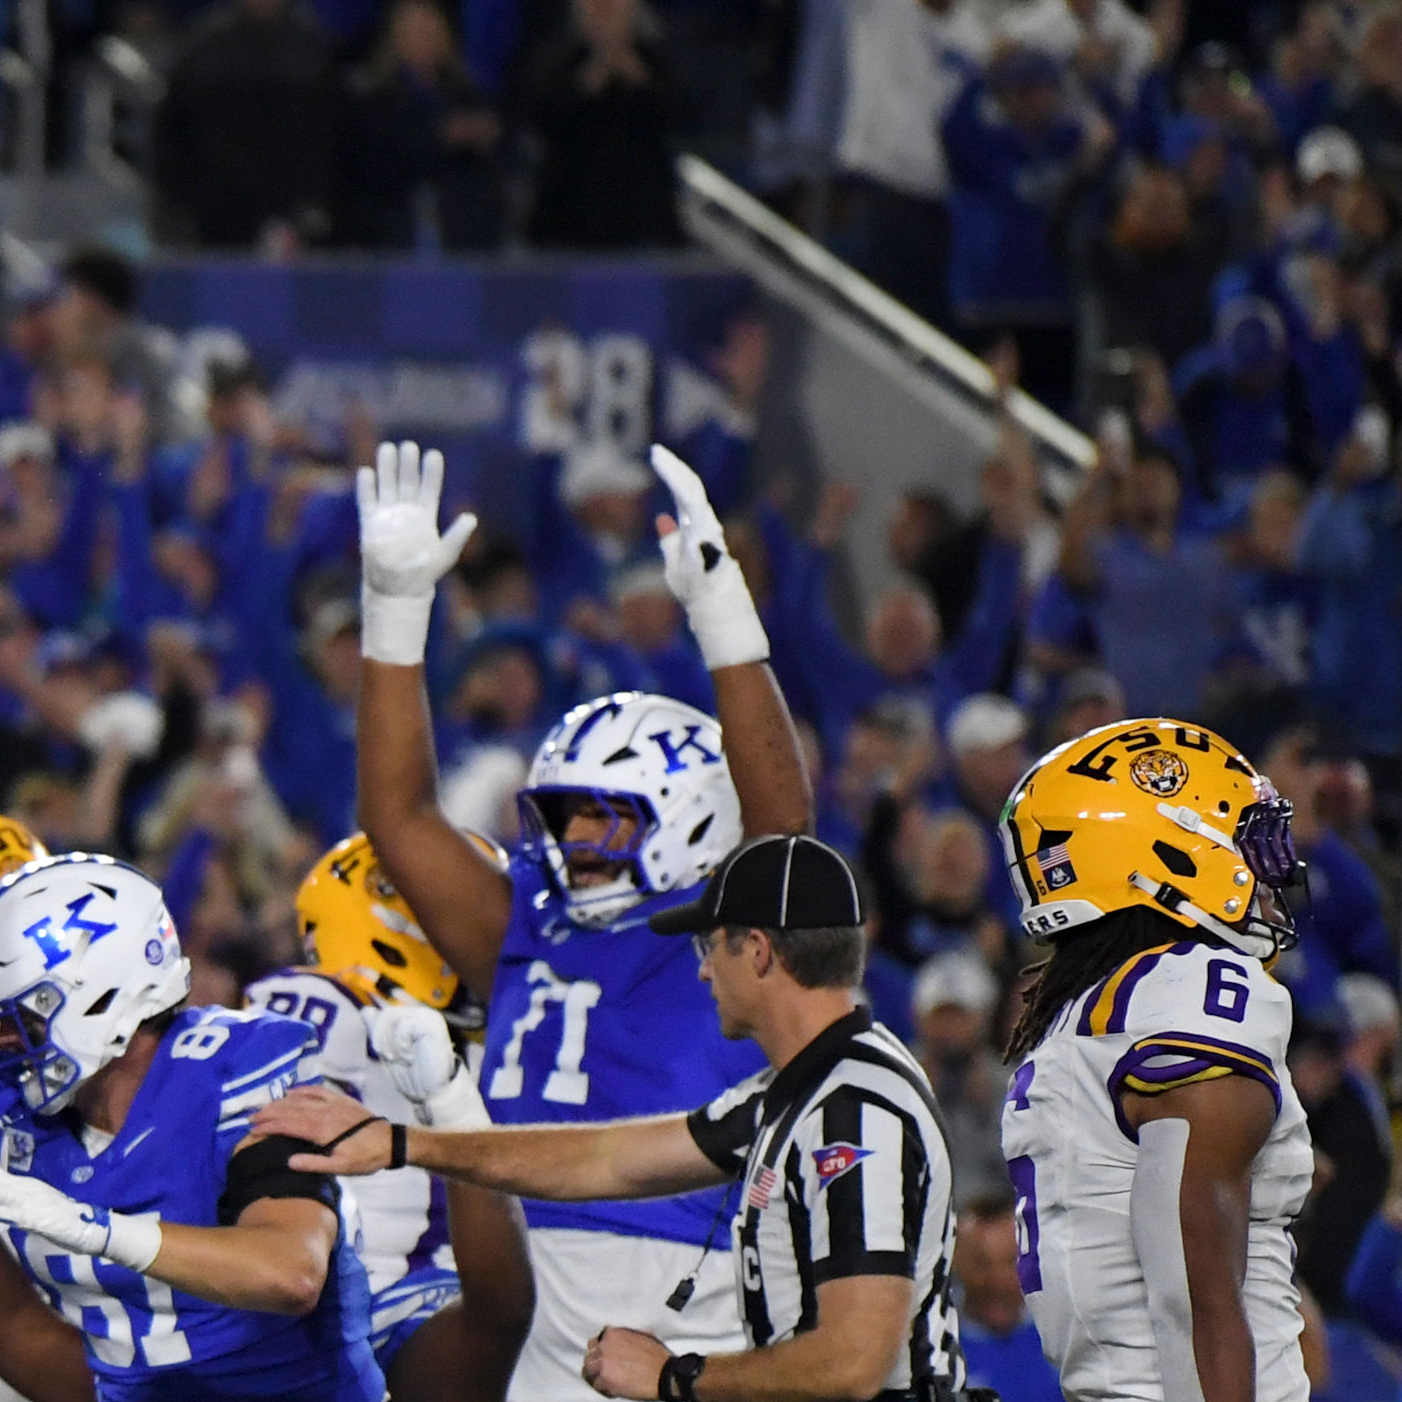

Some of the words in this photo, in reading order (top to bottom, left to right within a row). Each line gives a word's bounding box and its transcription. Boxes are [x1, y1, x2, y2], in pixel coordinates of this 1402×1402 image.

[648, 724, 720, 774] K
[1066, 726, 1210, 782] LSU
[22, 891, 118, 971] K
[1204, 958, 1250, 1024] 6
[488, 960, 602, 1106] 71
[742, 1245, 763, 1292] C
